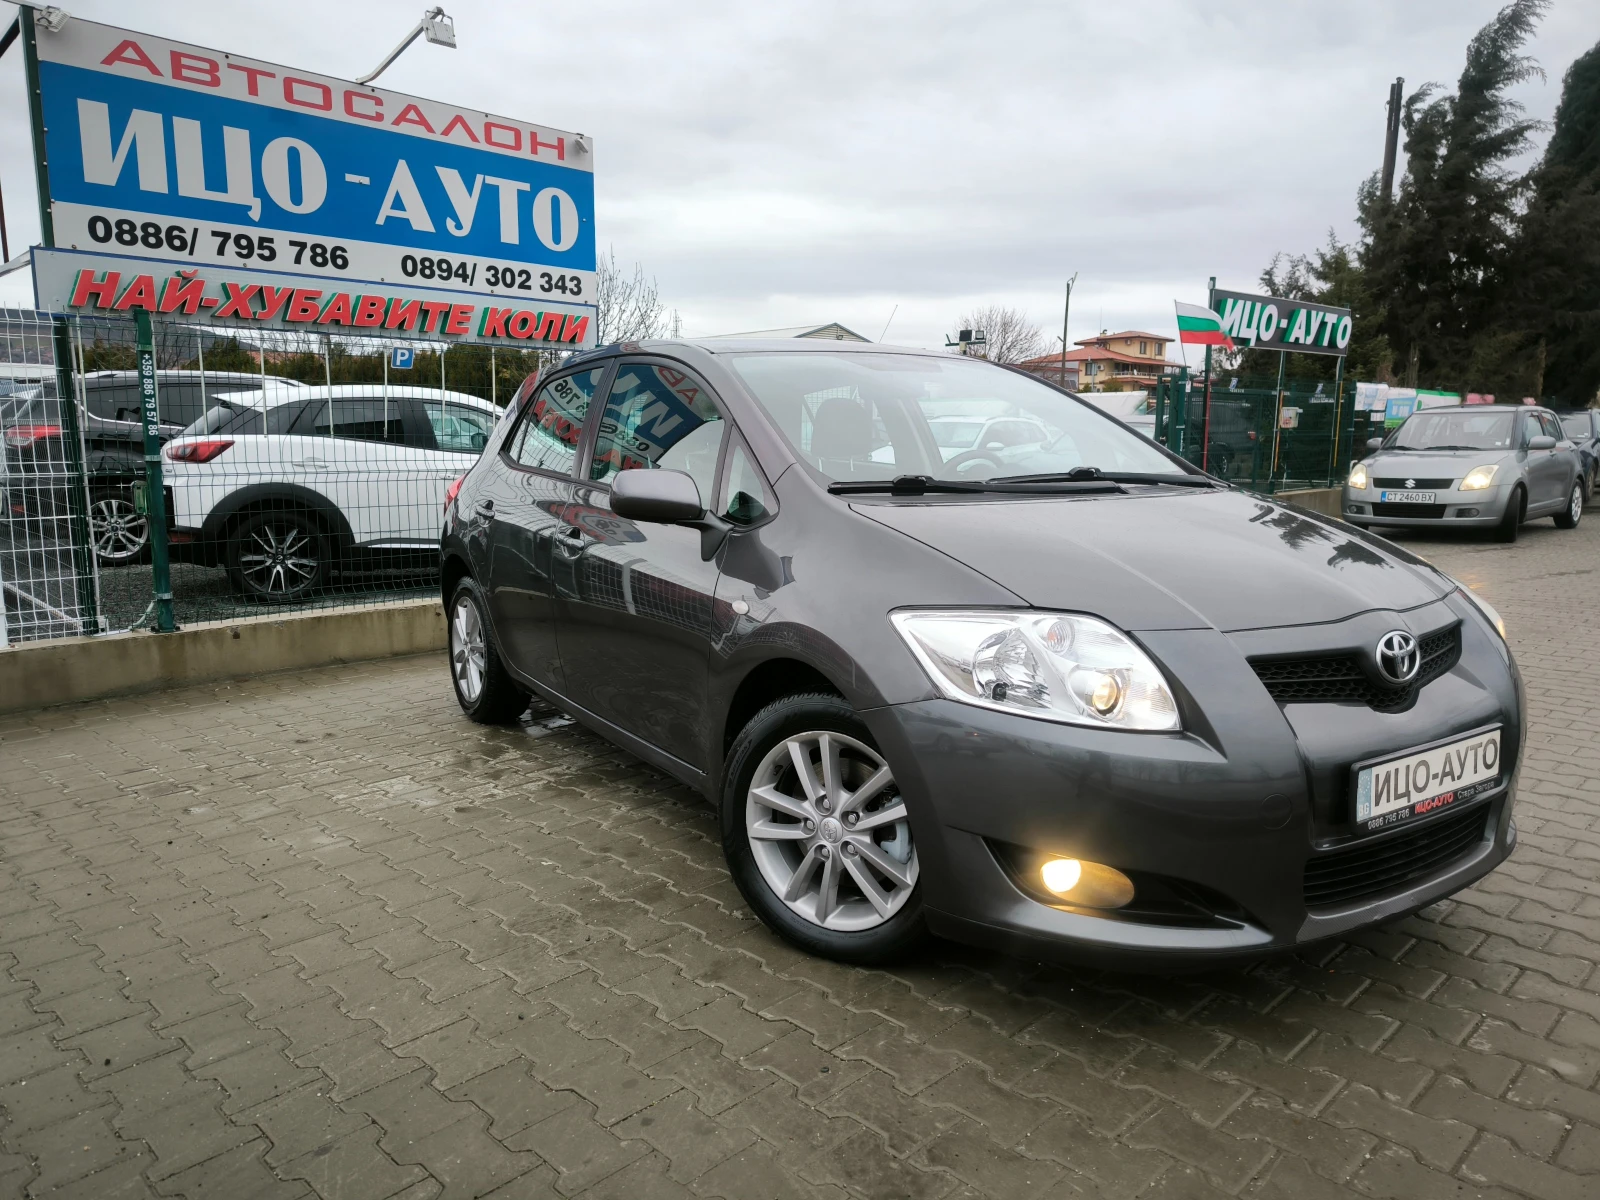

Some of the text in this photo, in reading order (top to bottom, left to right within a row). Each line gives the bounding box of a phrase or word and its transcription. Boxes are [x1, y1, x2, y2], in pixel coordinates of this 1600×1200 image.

[100, 39, 566, 162] АВТОСАЛОН
[87, 215, 349, 271] 0886/ 795 786
[69, 268, 591, 344] НАЙ-ХУБАВИТЕ КОЛИ
[400, 254, 583, 297] 0894/ 302 343
[1221, 297, 1353, 349] ИЦО-АУТО
[142, 353, 158, 436] +359 886 79 57 86
[1374, 738, 1498, 807] ИЦО-АУТО
[1414, 791, 1454, 814] ИЦО-АУТО
